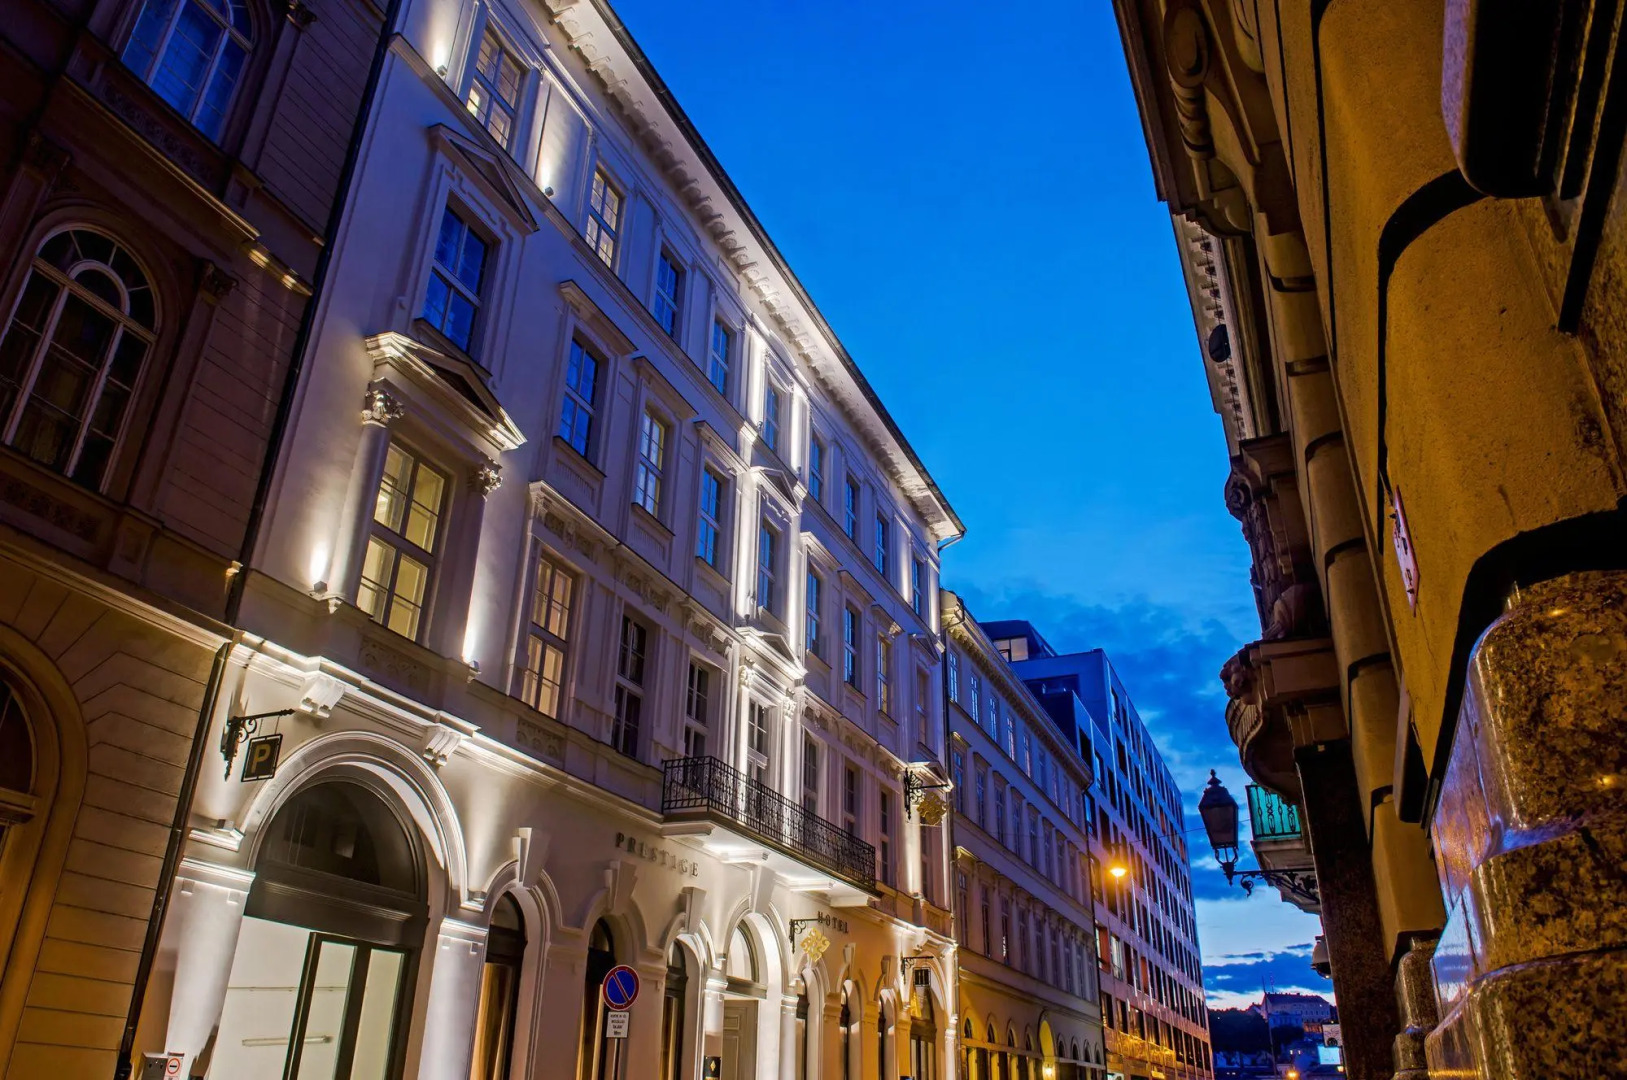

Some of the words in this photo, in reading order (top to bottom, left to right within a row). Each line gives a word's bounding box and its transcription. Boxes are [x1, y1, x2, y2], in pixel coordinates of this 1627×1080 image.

[251, 743, 271, 774] P
[615, 832, 699, 877] PRESTIGE
[818, 911, 848, 934] HOTEL
